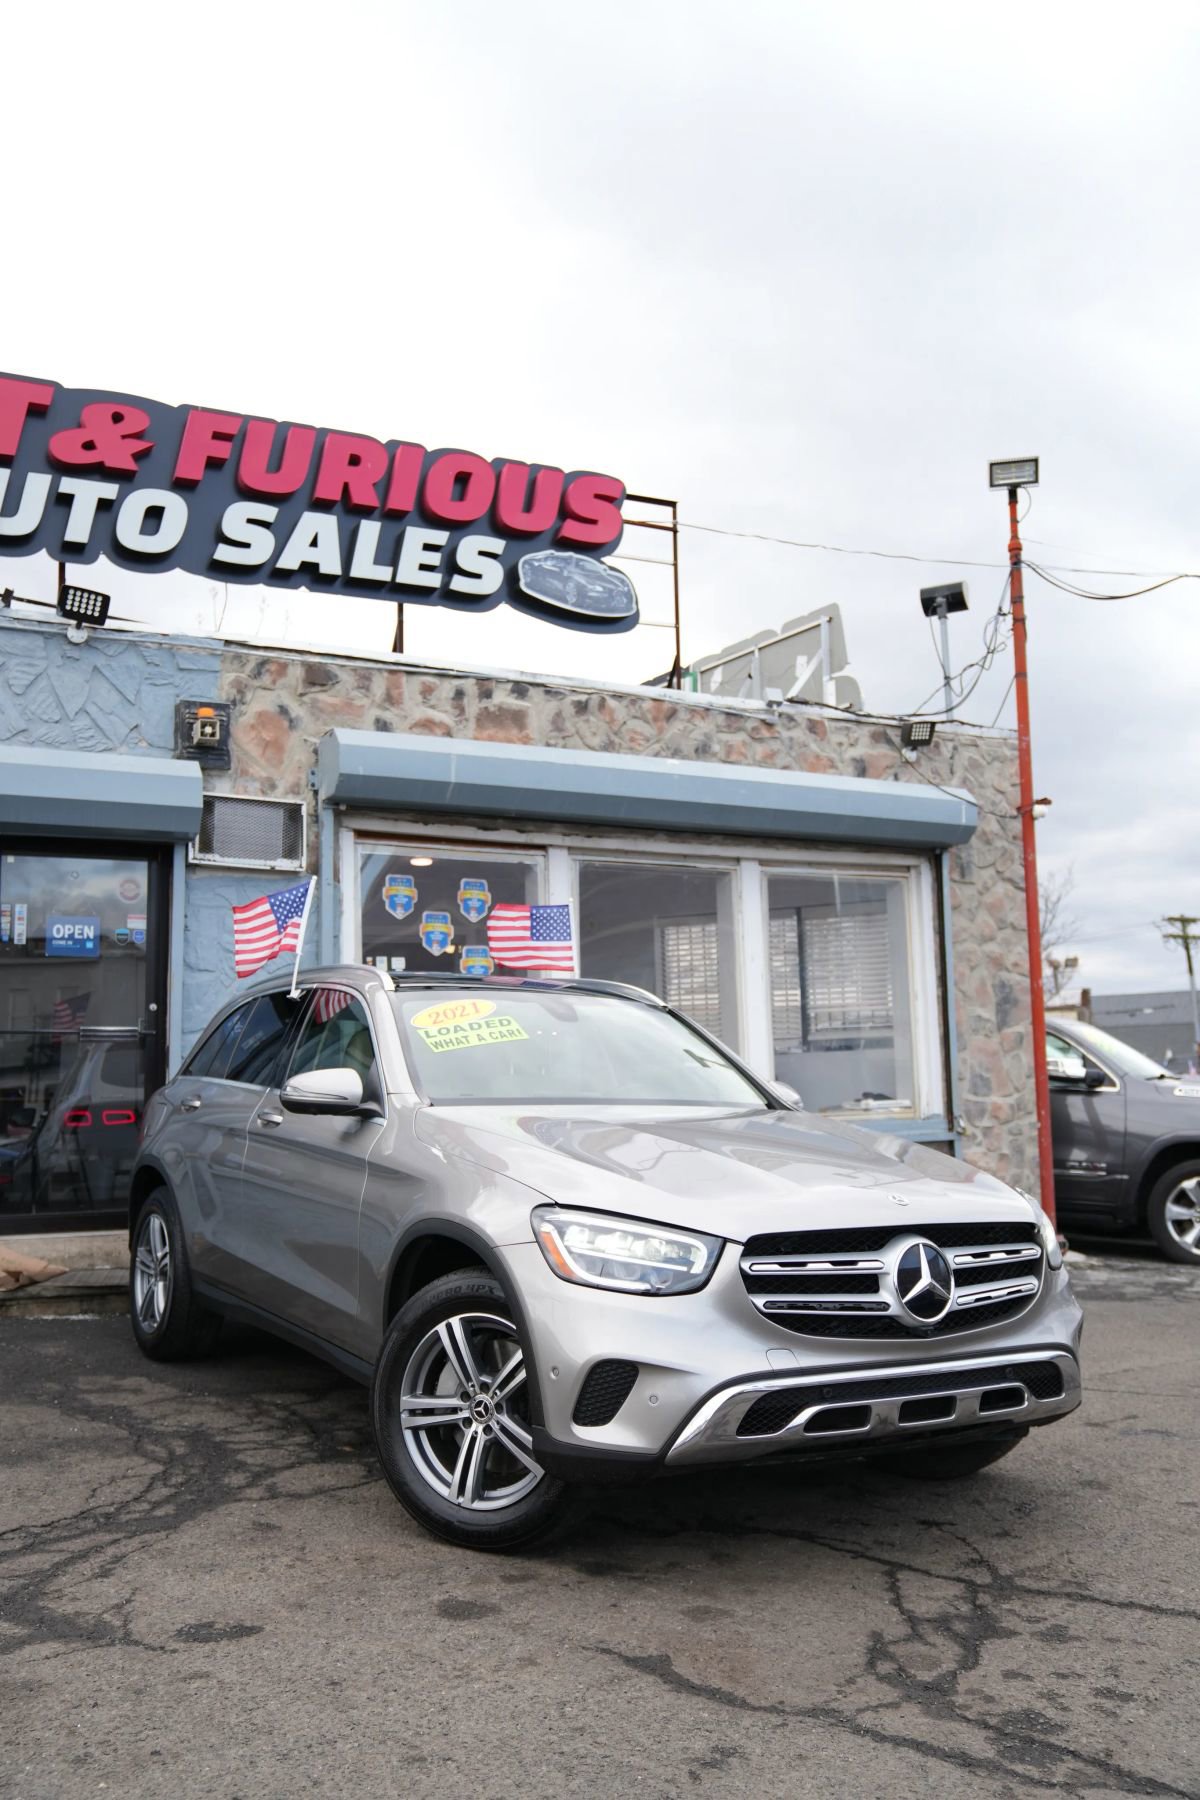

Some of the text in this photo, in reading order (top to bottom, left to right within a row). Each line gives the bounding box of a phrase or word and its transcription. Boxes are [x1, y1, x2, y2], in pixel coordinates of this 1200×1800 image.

[48, 402, 155, 472] &
[174, 409, 625, 545] FURIOUS
[213, 501, 506, 596] SALES
[52, 924, 95, 940] OPEN
[428, 1001, 481, 1025] 2021
[424, 1018, 512, 1039] LOADED
[430, 1035, 471, 1051] WHAT
[476, 1033, 487, 1042] A
